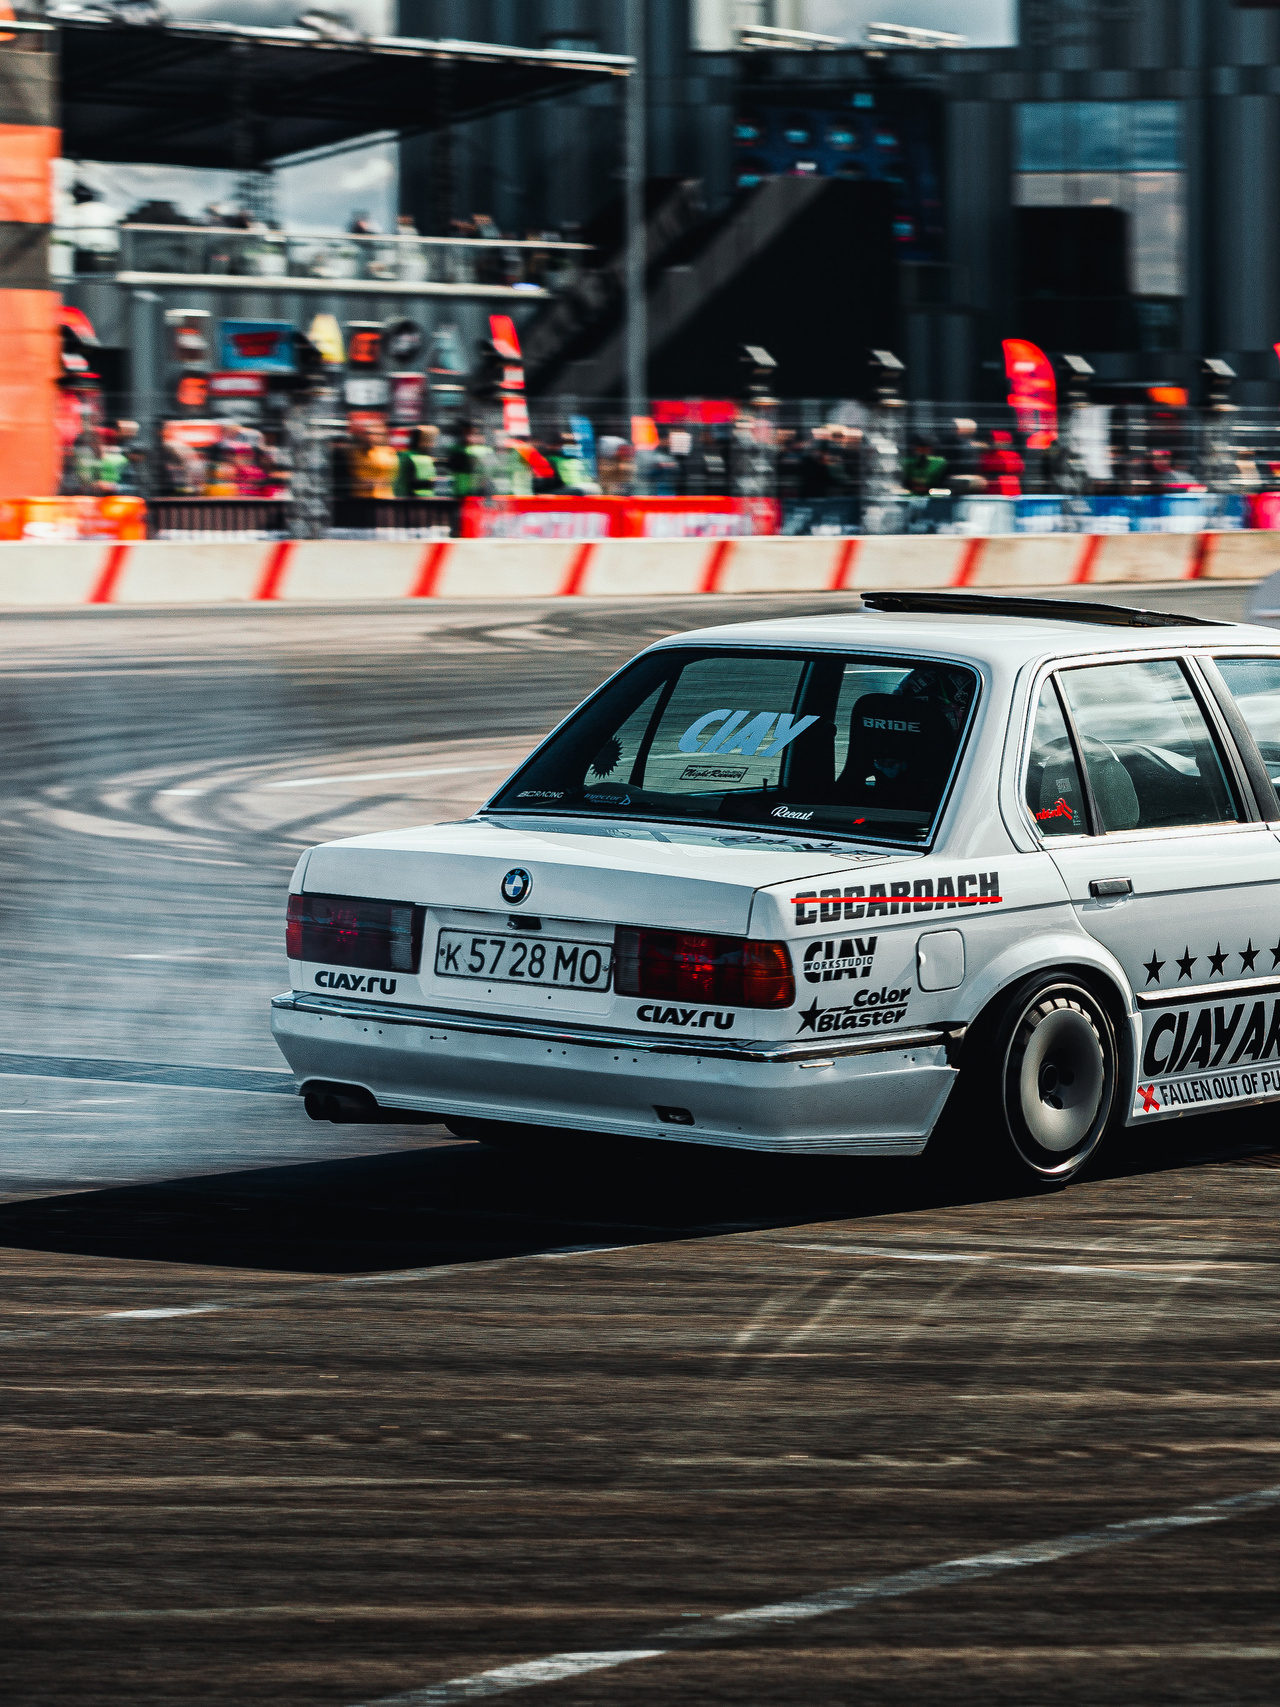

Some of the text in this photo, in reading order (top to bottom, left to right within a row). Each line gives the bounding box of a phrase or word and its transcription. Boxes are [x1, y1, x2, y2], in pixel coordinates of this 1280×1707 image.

[862, 716, 921, 733] BRIDE
[795, 872, 999, 926] COCAROACH
[468, 938, 546, 979] 5728
[803, 956, 874, 971] WORKSTUDIO
[853, 986, 912, 1008] Color
[817, 1008, 908, 1033] Blaster
[1159, 1079, 1213, 1107] FALLEN
[1212, 1076, 1243, 1099] OUT
[1241, 1073, 1259, 1096] OF
